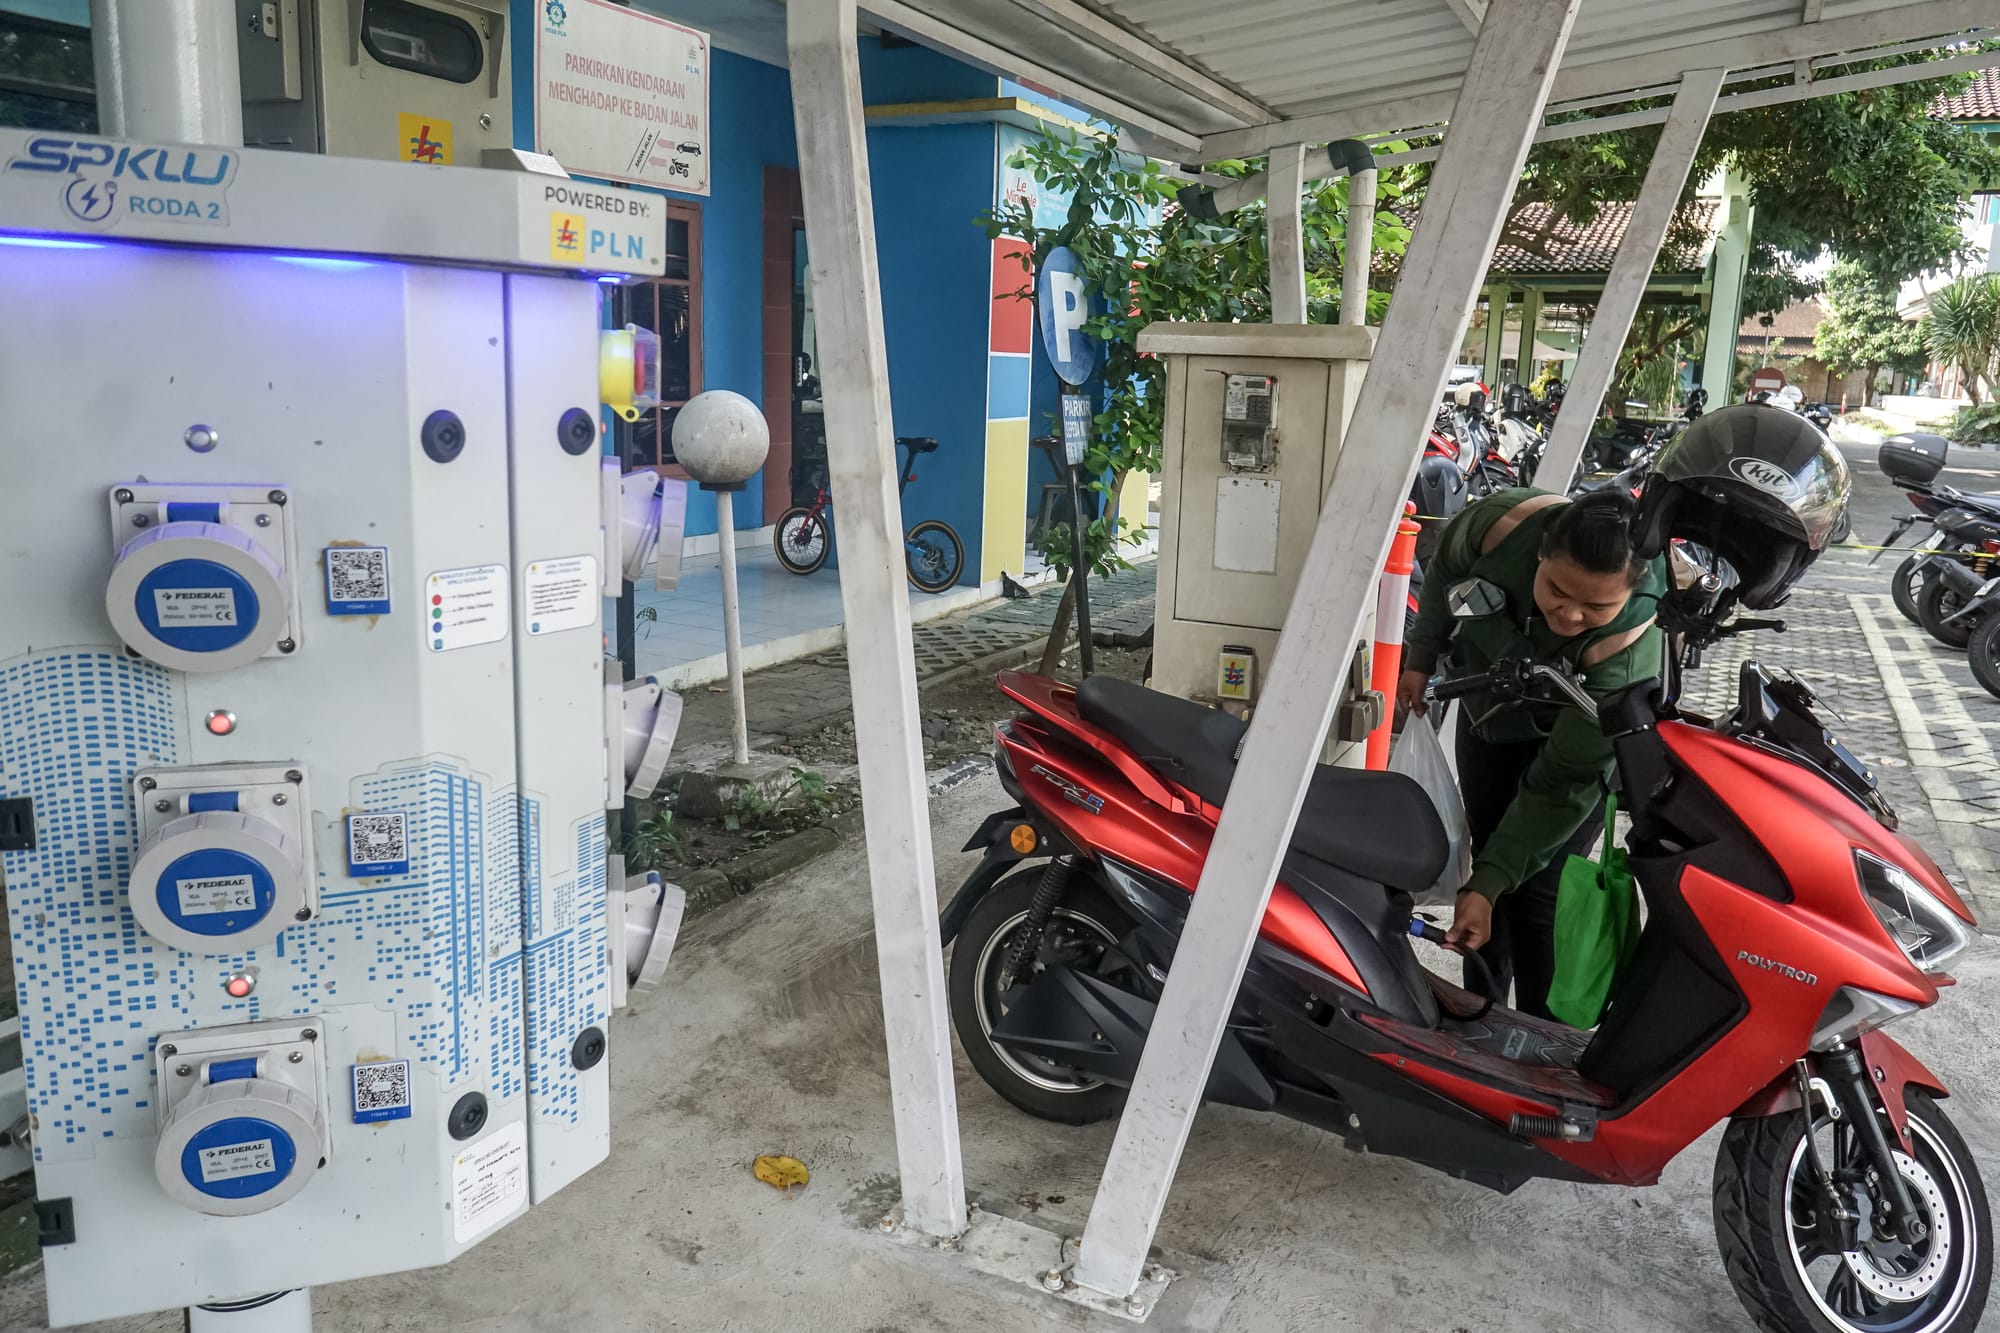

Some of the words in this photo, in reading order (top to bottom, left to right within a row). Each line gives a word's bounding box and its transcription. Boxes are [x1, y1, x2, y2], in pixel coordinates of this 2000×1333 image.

[565, 52, 624, 85] PARKIRKAN
[626, 69, 685, 100] KENDARAAN
[685, 64, 700, 75] PLN
[549, 80, 618, 113] MENGHADAP
[619, 98, 633, 117] KE
[634, 104, 668, 126] BADAN
[669, 110, 698, 131] JALAN
[10, 138, 230, 186] SPKLU
[1016, 176, 1027, 193] Le
[129, 195, 201, 218] RODA
[207, 202, 220, 220] 2
[545, 186, 625, 214] POWERED
[628, 200, 650, 218] BY:
[591, 229, 643, 260] PLN
[1050, 271, 1088, 363] P
[1064, 400, 1091, 417] PARKIR
[1737, 950, 1818, 986] POLYTRON
